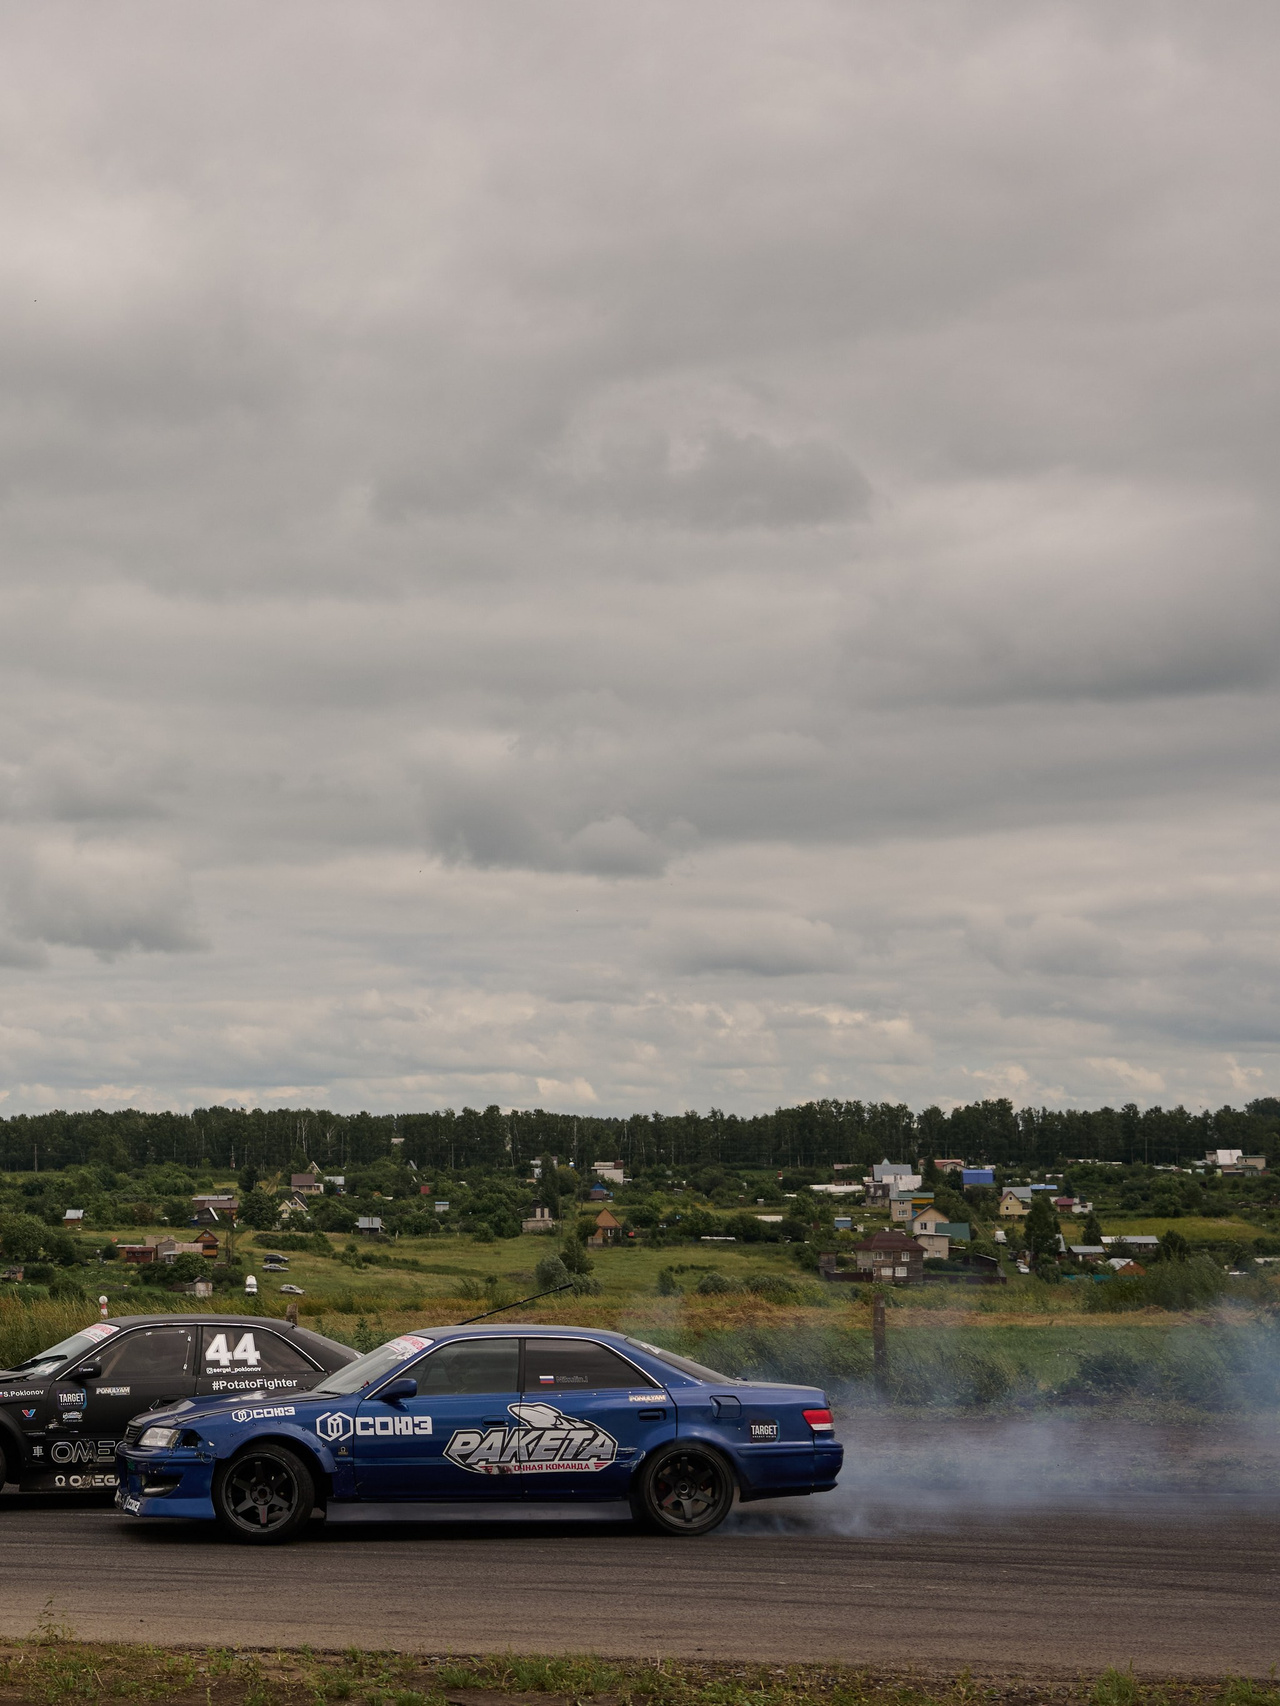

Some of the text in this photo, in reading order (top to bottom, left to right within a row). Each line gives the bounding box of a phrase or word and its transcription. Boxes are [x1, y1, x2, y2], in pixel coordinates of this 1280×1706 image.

[205, 1333, 261, 1366] 44
[212, 1379, 298, 1391] #PotatoFighter
[58, 1393, 84, 1403] TARGET
[253, 1406, 296, 1419] СОЮЗ
[354, 1416, 433, 1436] СОЮЗ
[750, 1425, 778, 1435] TARGET
[51, 1440, 124, 1464] OME
[545, 1462, 591, 1471] КОМАНДА
